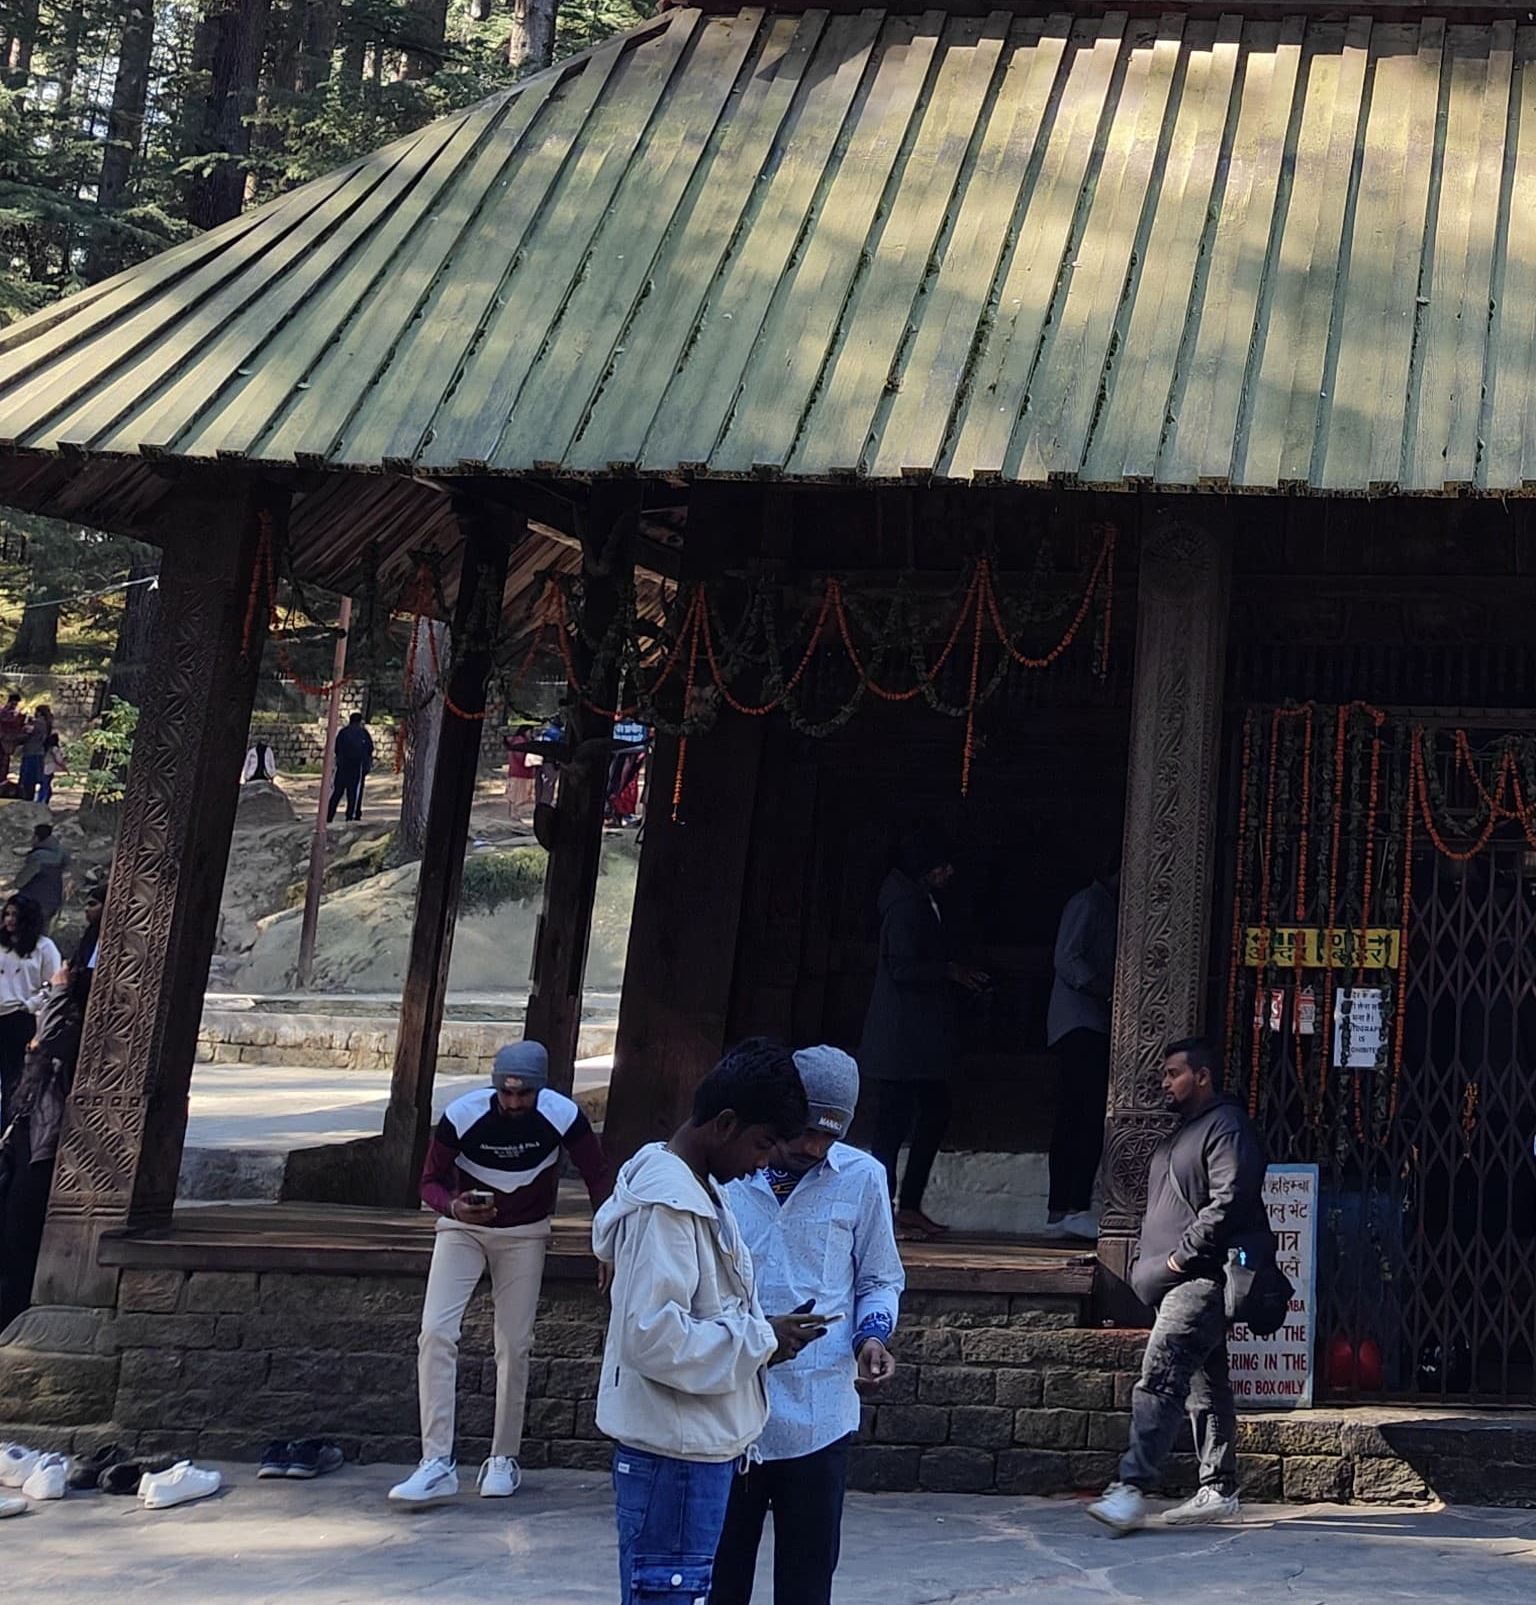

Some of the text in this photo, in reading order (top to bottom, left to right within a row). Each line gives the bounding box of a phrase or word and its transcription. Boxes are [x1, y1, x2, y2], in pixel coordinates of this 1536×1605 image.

[1283, 1325, 1306, 1342] THE
[1264, 1353, 1278, 1370] IN
[1282, 1353, 1307, 1371] THE
[1255, 1380, 1276, 1395] BOX
[1278, 1380, 1305, 1395] ONLY
